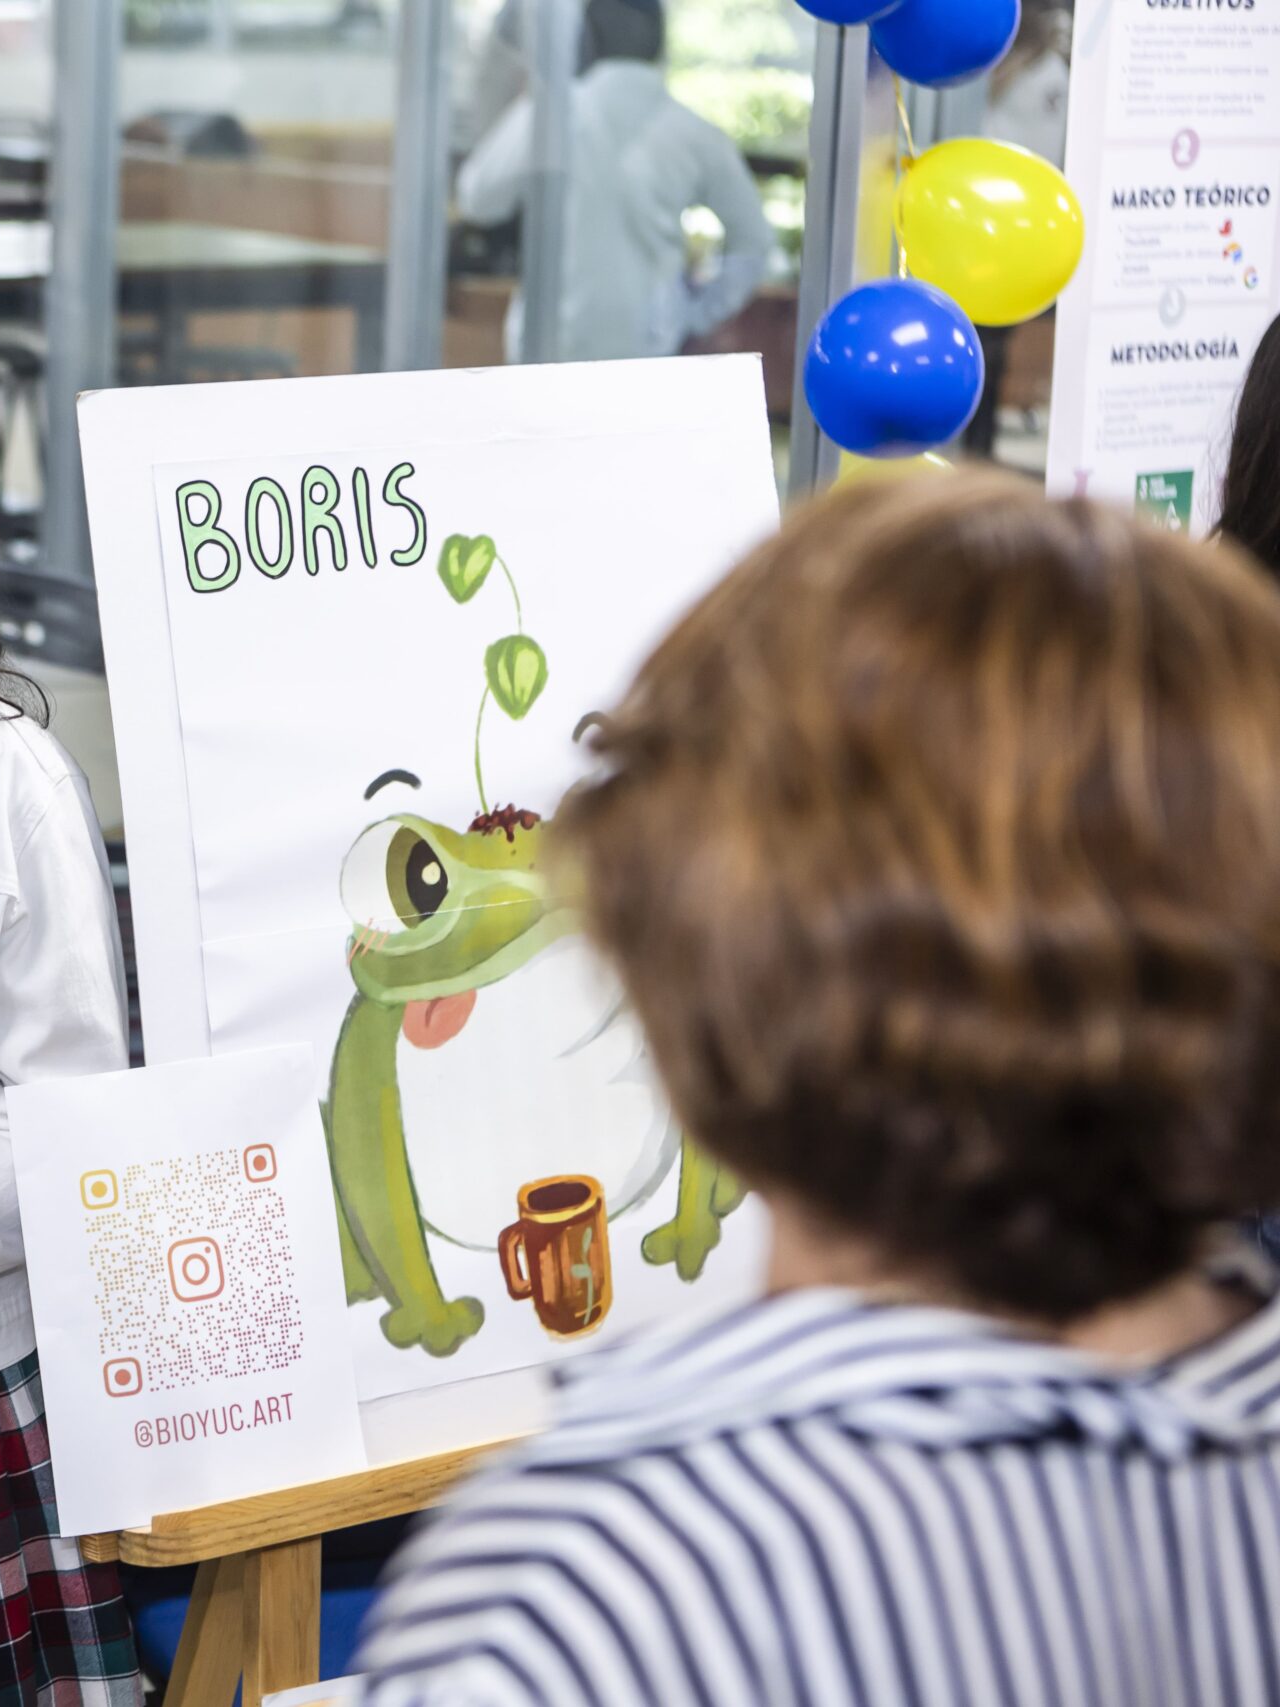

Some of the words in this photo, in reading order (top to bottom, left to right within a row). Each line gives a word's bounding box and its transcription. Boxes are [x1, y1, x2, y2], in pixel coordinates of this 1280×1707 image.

[1112, 186, 1176, 209] MARCO
[1183, 181, 1271, 208] TEÓRICO
[1110, 335, 1239, 364] METODOLOGÍA
[176, 461, 427, 594] BORIS
[133, 1393, 294, 1449] @BIOYUC.ART
